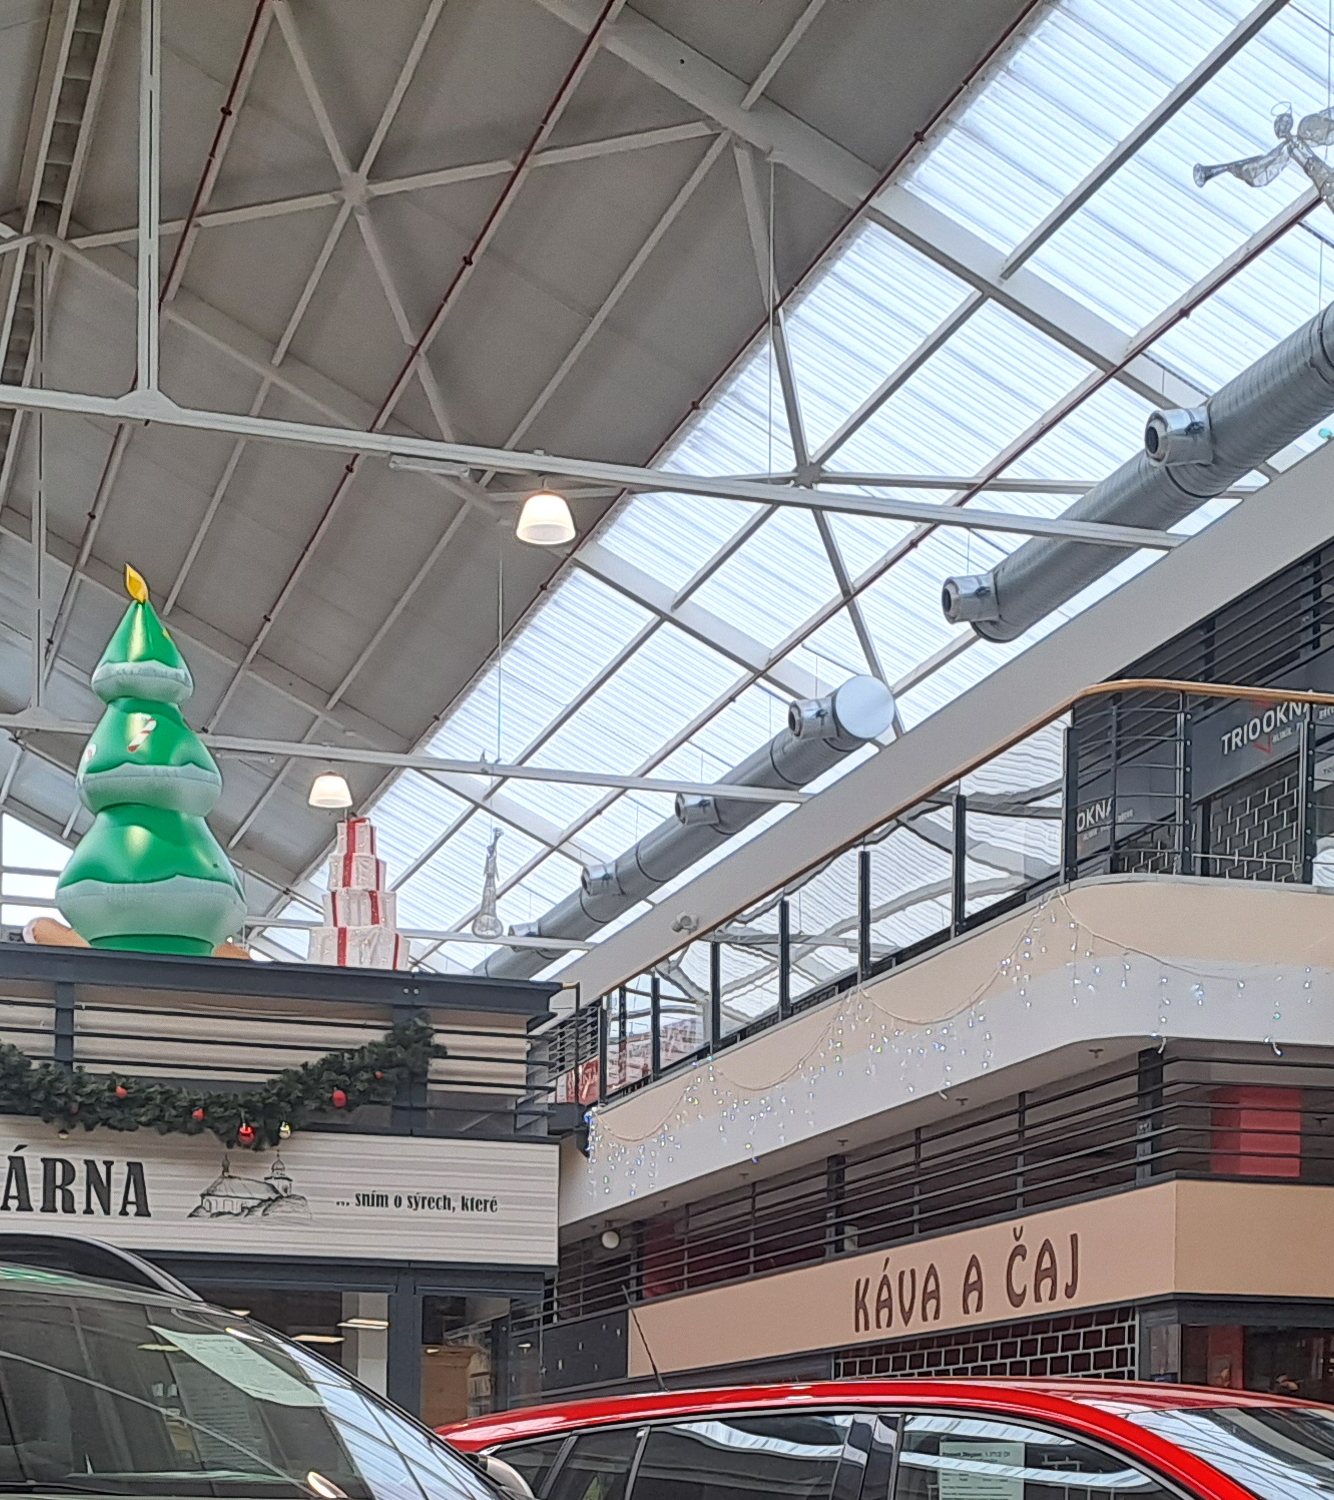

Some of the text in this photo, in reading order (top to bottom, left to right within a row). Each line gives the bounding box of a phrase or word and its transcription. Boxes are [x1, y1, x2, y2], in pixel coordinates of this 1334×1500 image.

[355, 1190, 389, 1208] sním
[394, 1194, 403, 1208] o
[407, 1192, 456, 1213] sýrech,
[461, 1195, 498, 1213] které
[854, 1225, 1079, 1333] KÁVA A ČAJ
